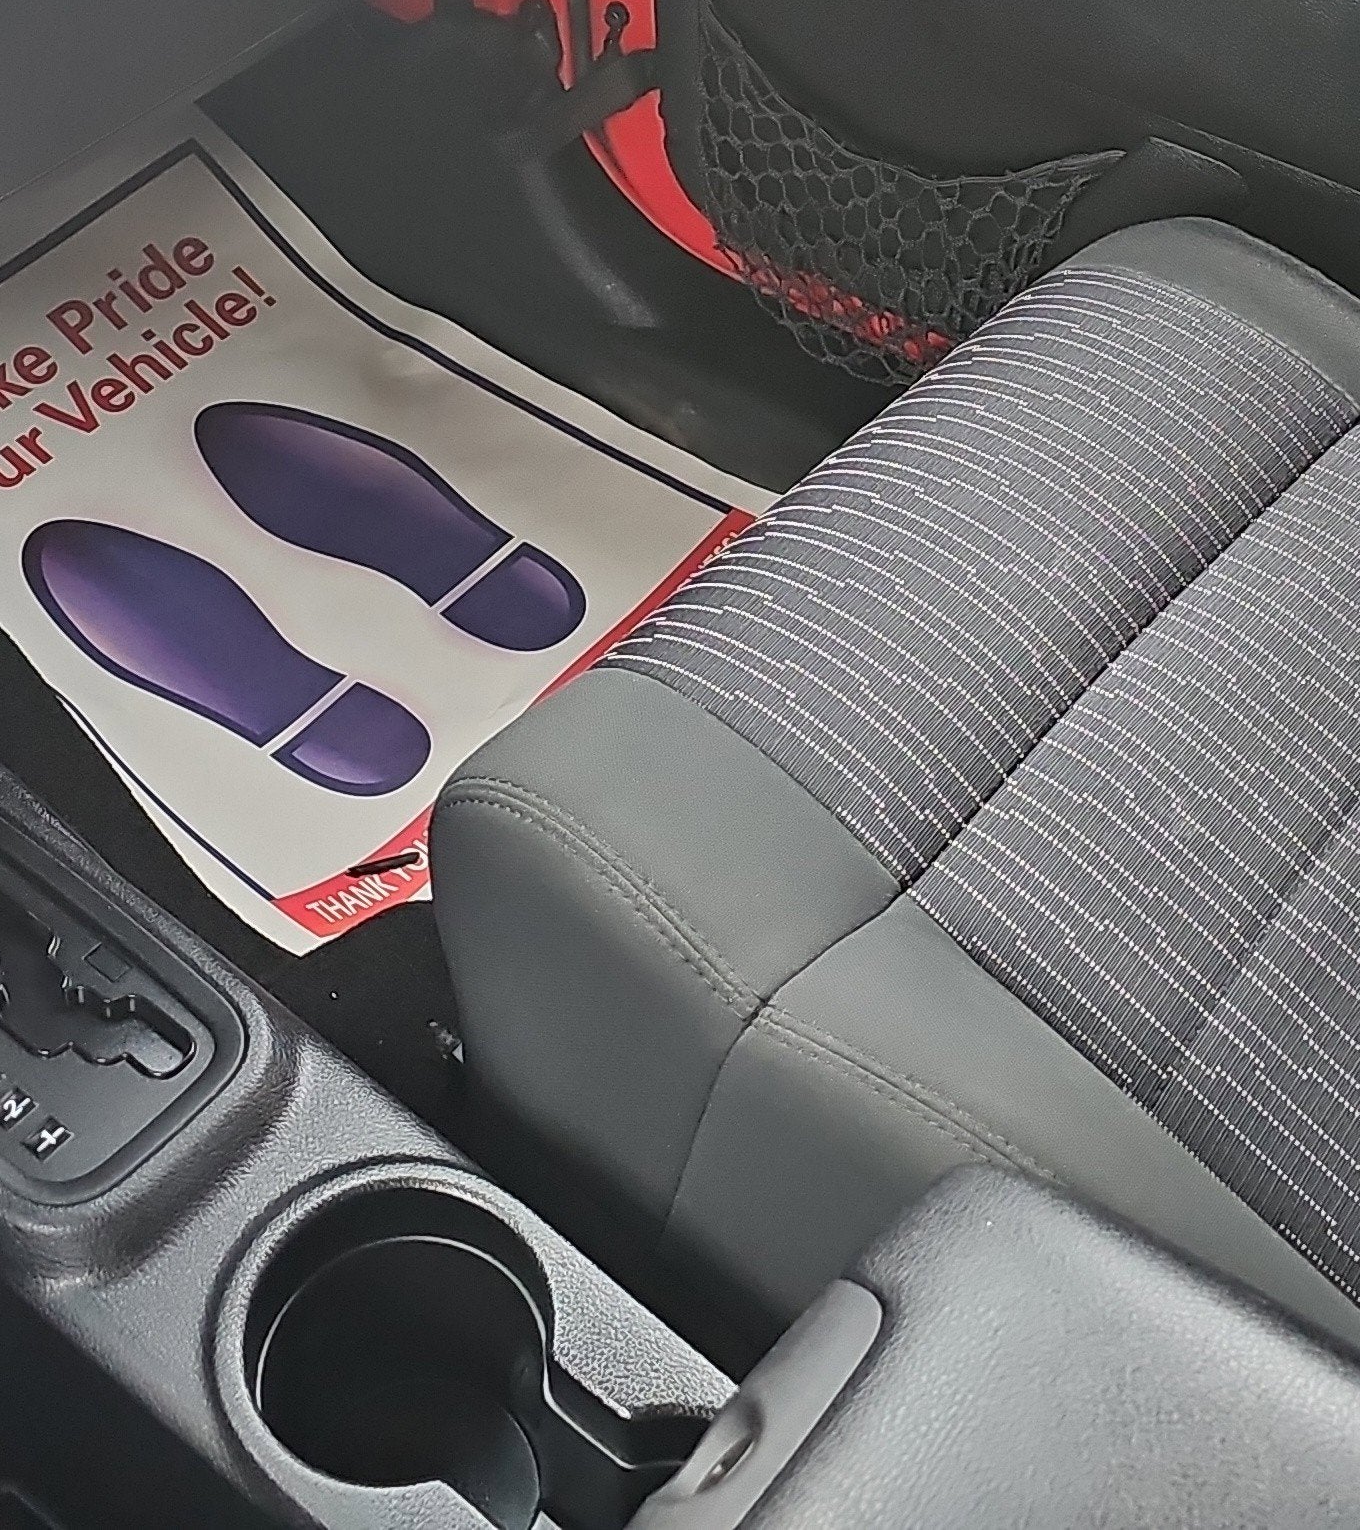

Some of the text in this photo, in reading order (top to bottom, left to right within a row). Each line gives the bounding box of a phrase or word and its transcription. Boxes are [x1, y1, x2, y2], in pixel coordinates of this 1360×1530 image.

[47, 233, 216, 357] Pride
[33, 264, 278, 437] Vehicle!
[305, 872, 400, 923] THANK
[2, 1099, 25, 1122] 2
